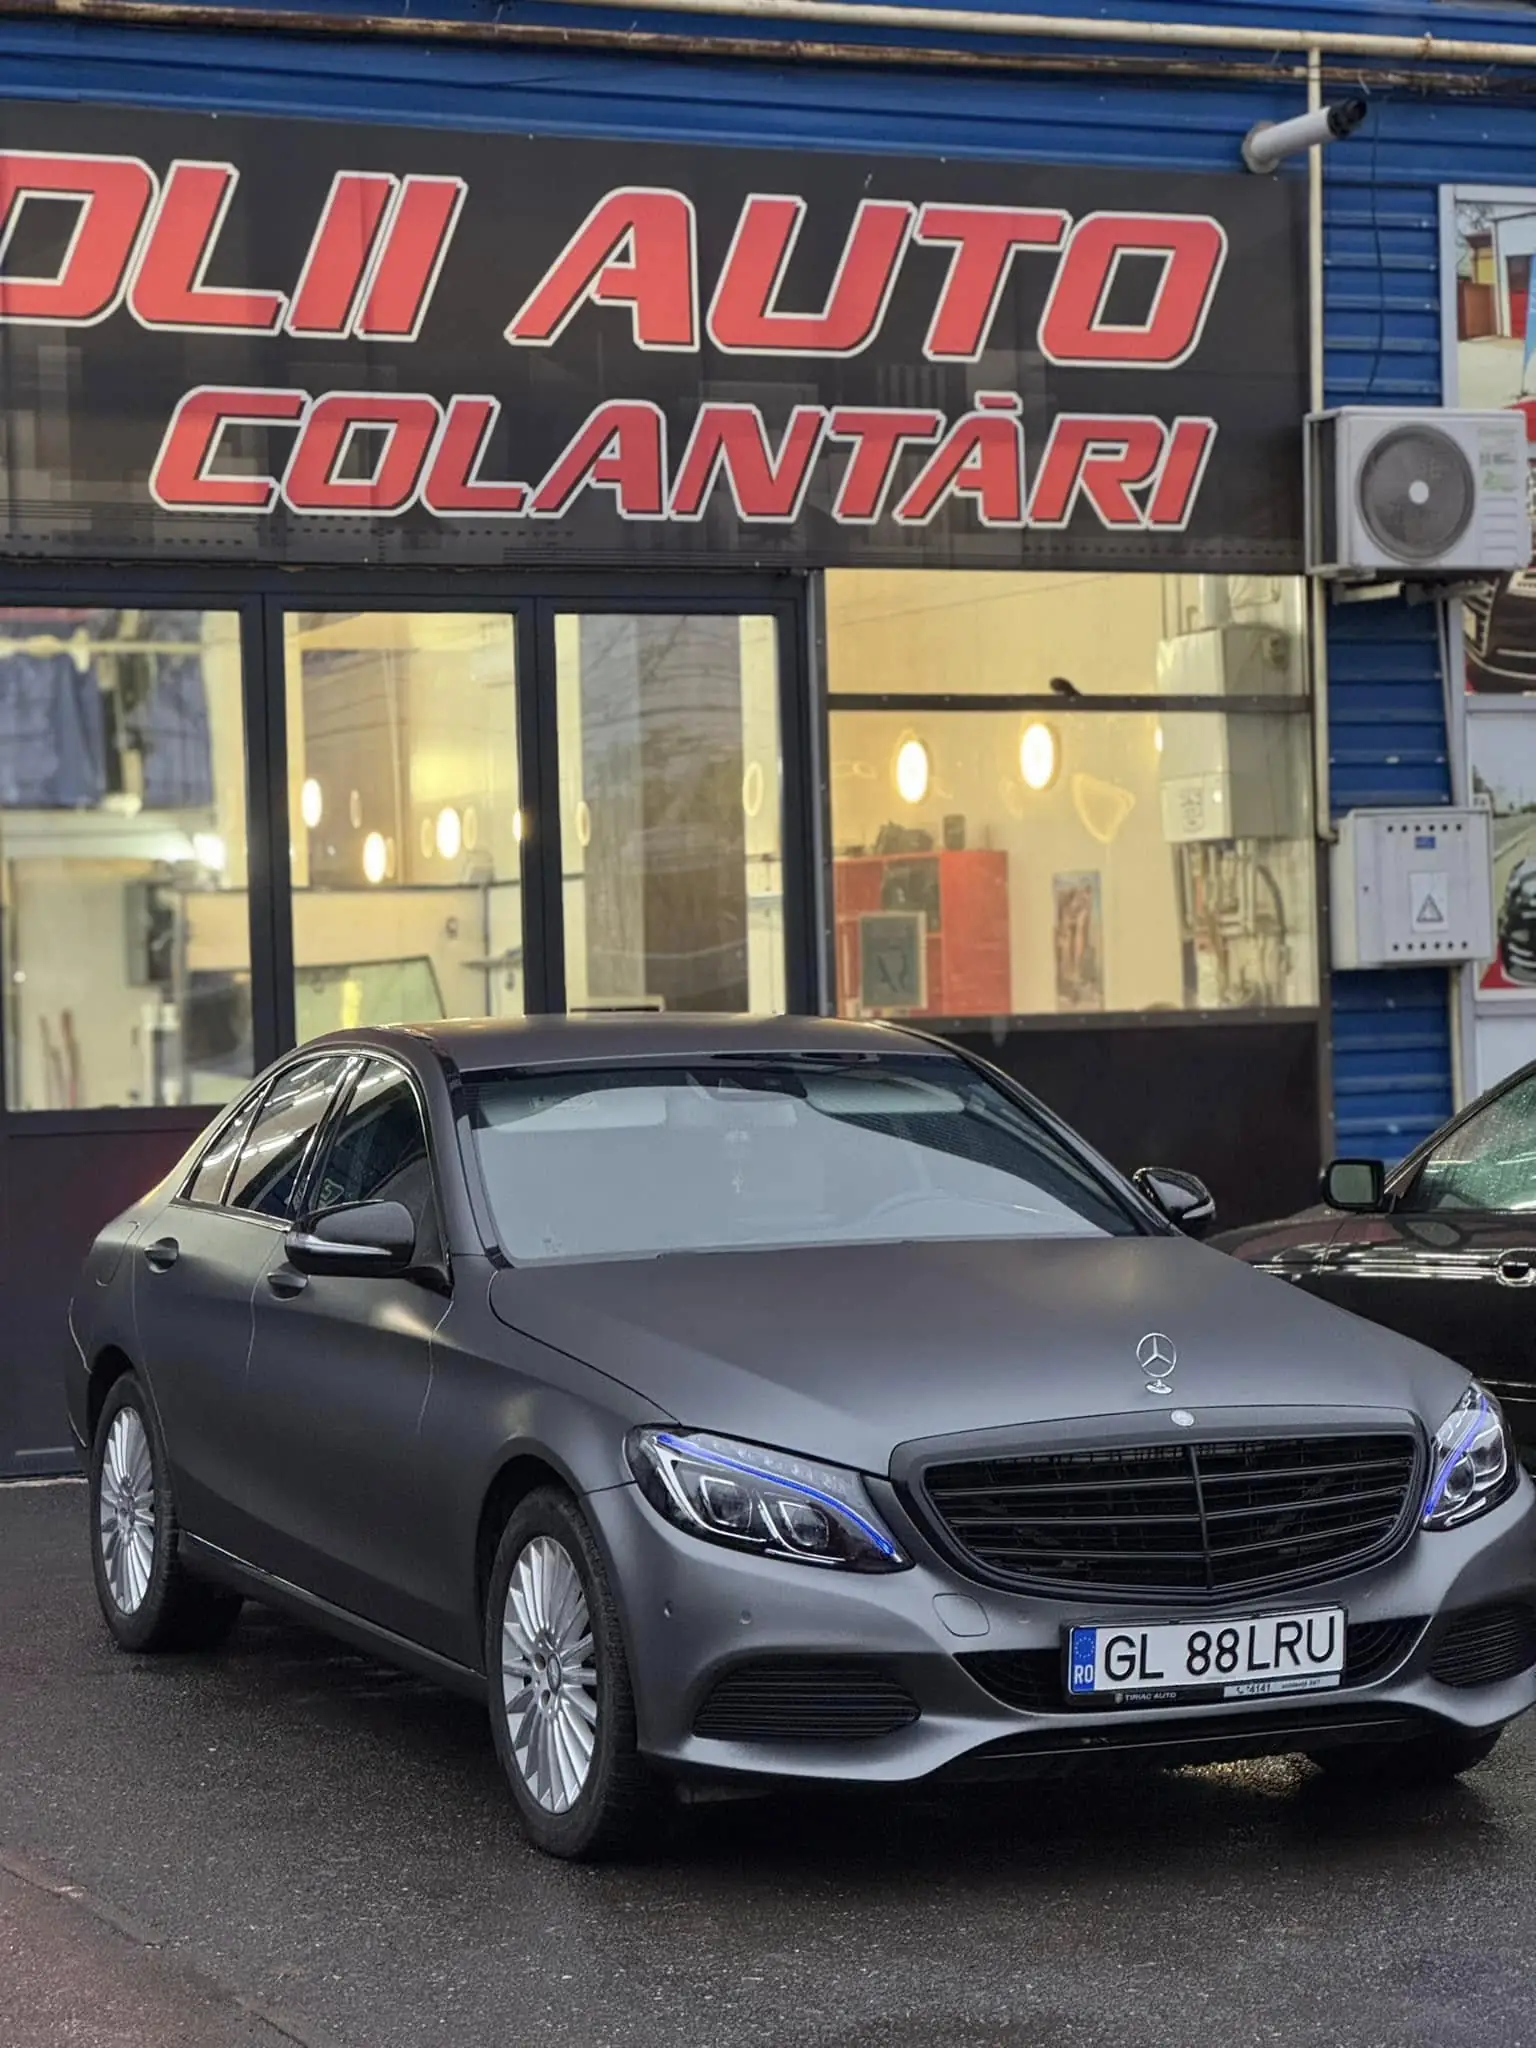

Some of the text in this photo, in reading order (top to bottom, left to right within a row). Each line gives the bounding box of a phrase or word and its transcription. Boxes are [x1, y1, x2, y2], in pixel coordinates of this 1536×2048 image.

[504, 186, 1229, 369] AUTO
[1074, 1664, 1094, 1685] RO
[1104, 1633, 1164, 1682] GL
[1153, 1691, 1177, 1699] AUTO
